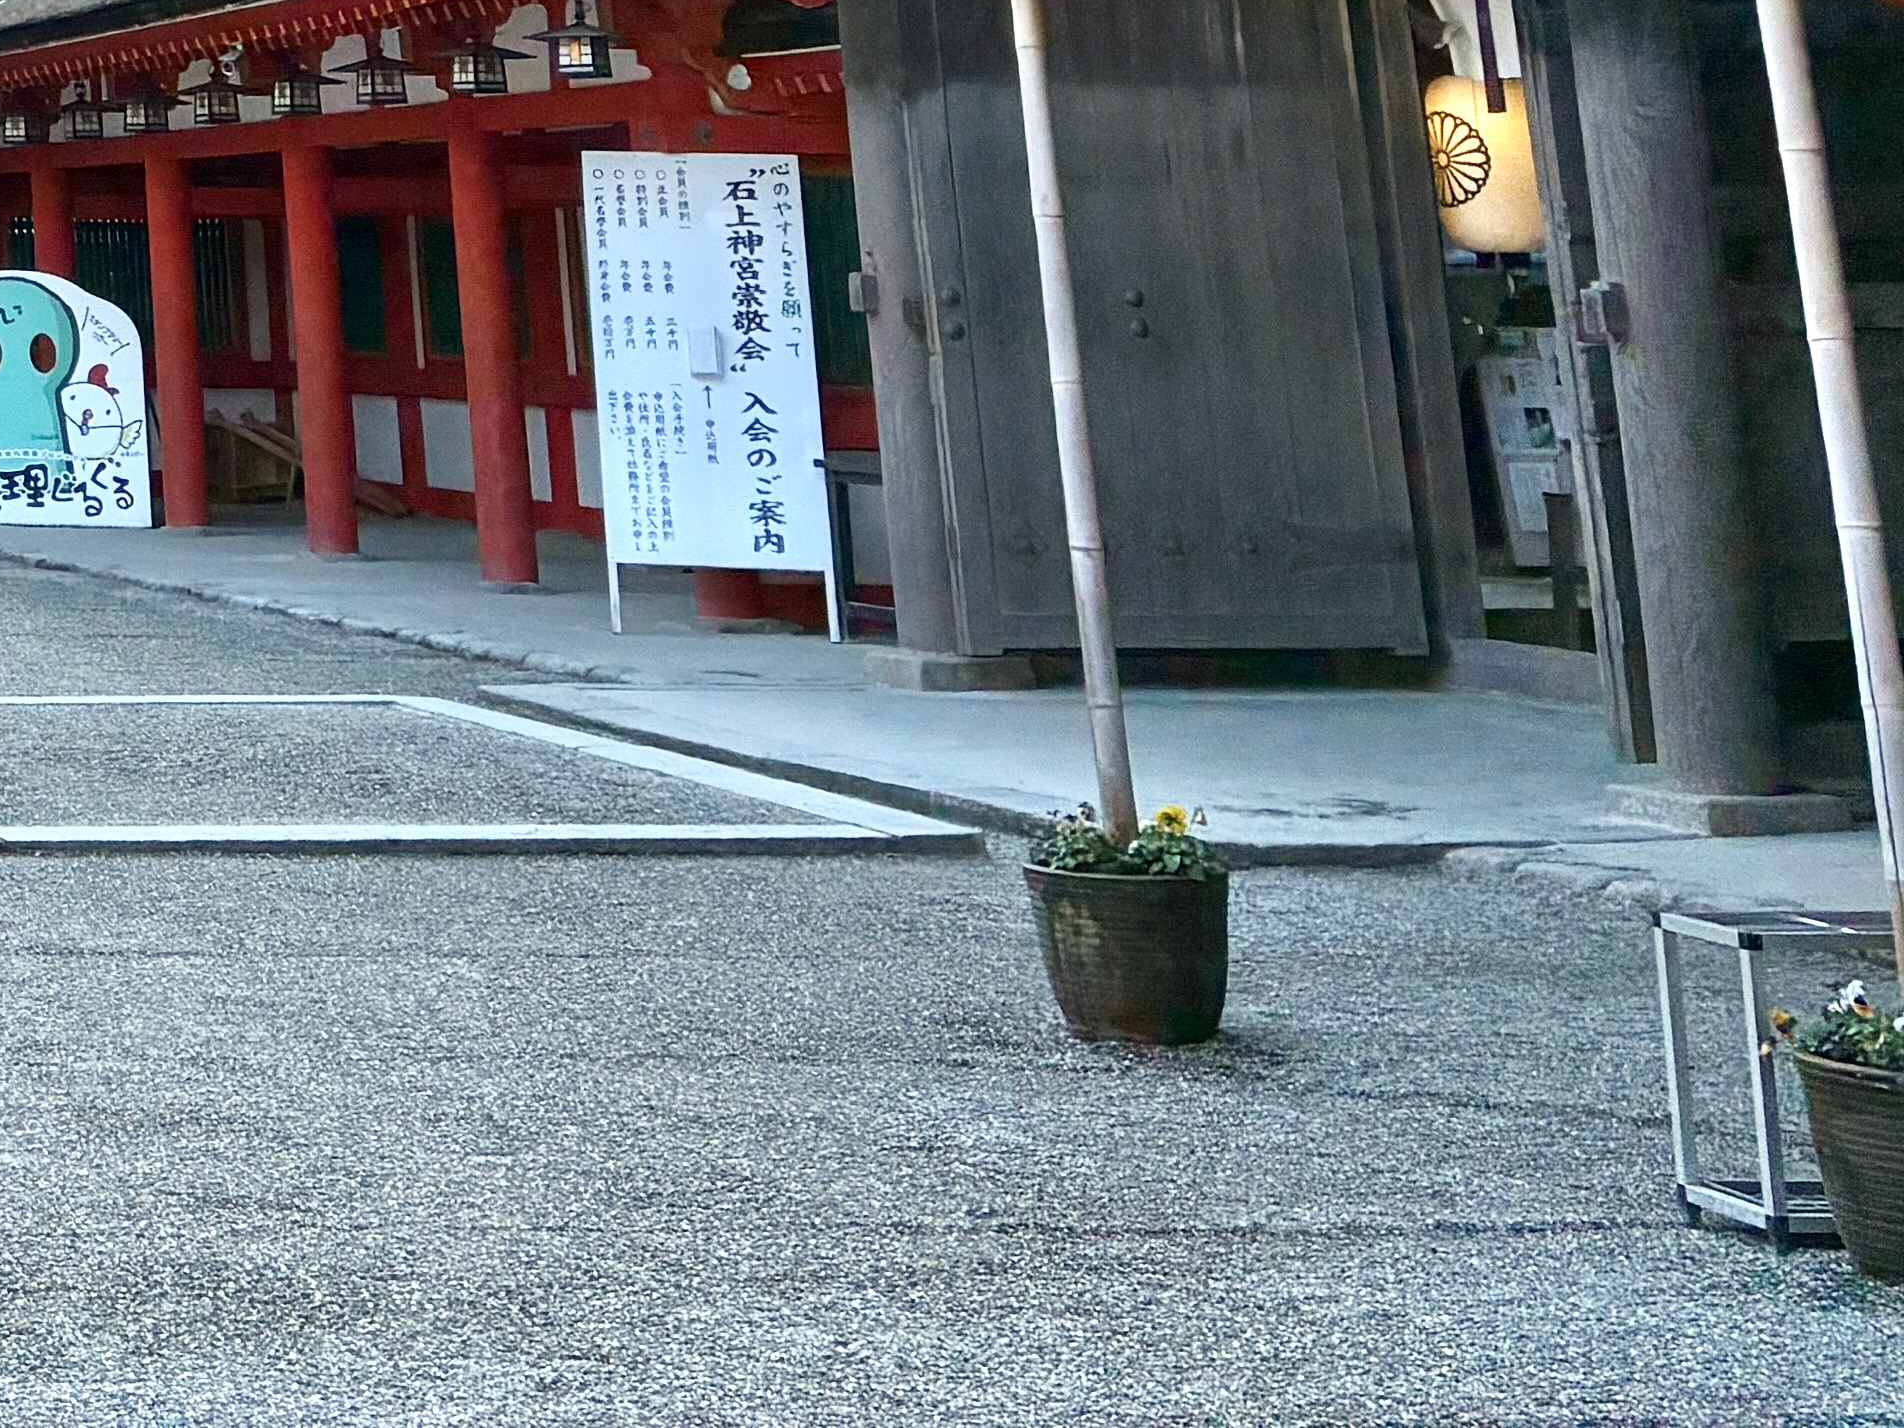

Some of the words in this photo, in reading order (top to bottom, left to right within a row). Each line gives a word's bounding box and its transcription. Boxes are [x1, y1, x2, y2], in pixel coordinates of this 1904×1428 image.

[770, 162, 802, 359] 心のやすらぎを願って
[740, 391, 787, 555] 入会のご案内
